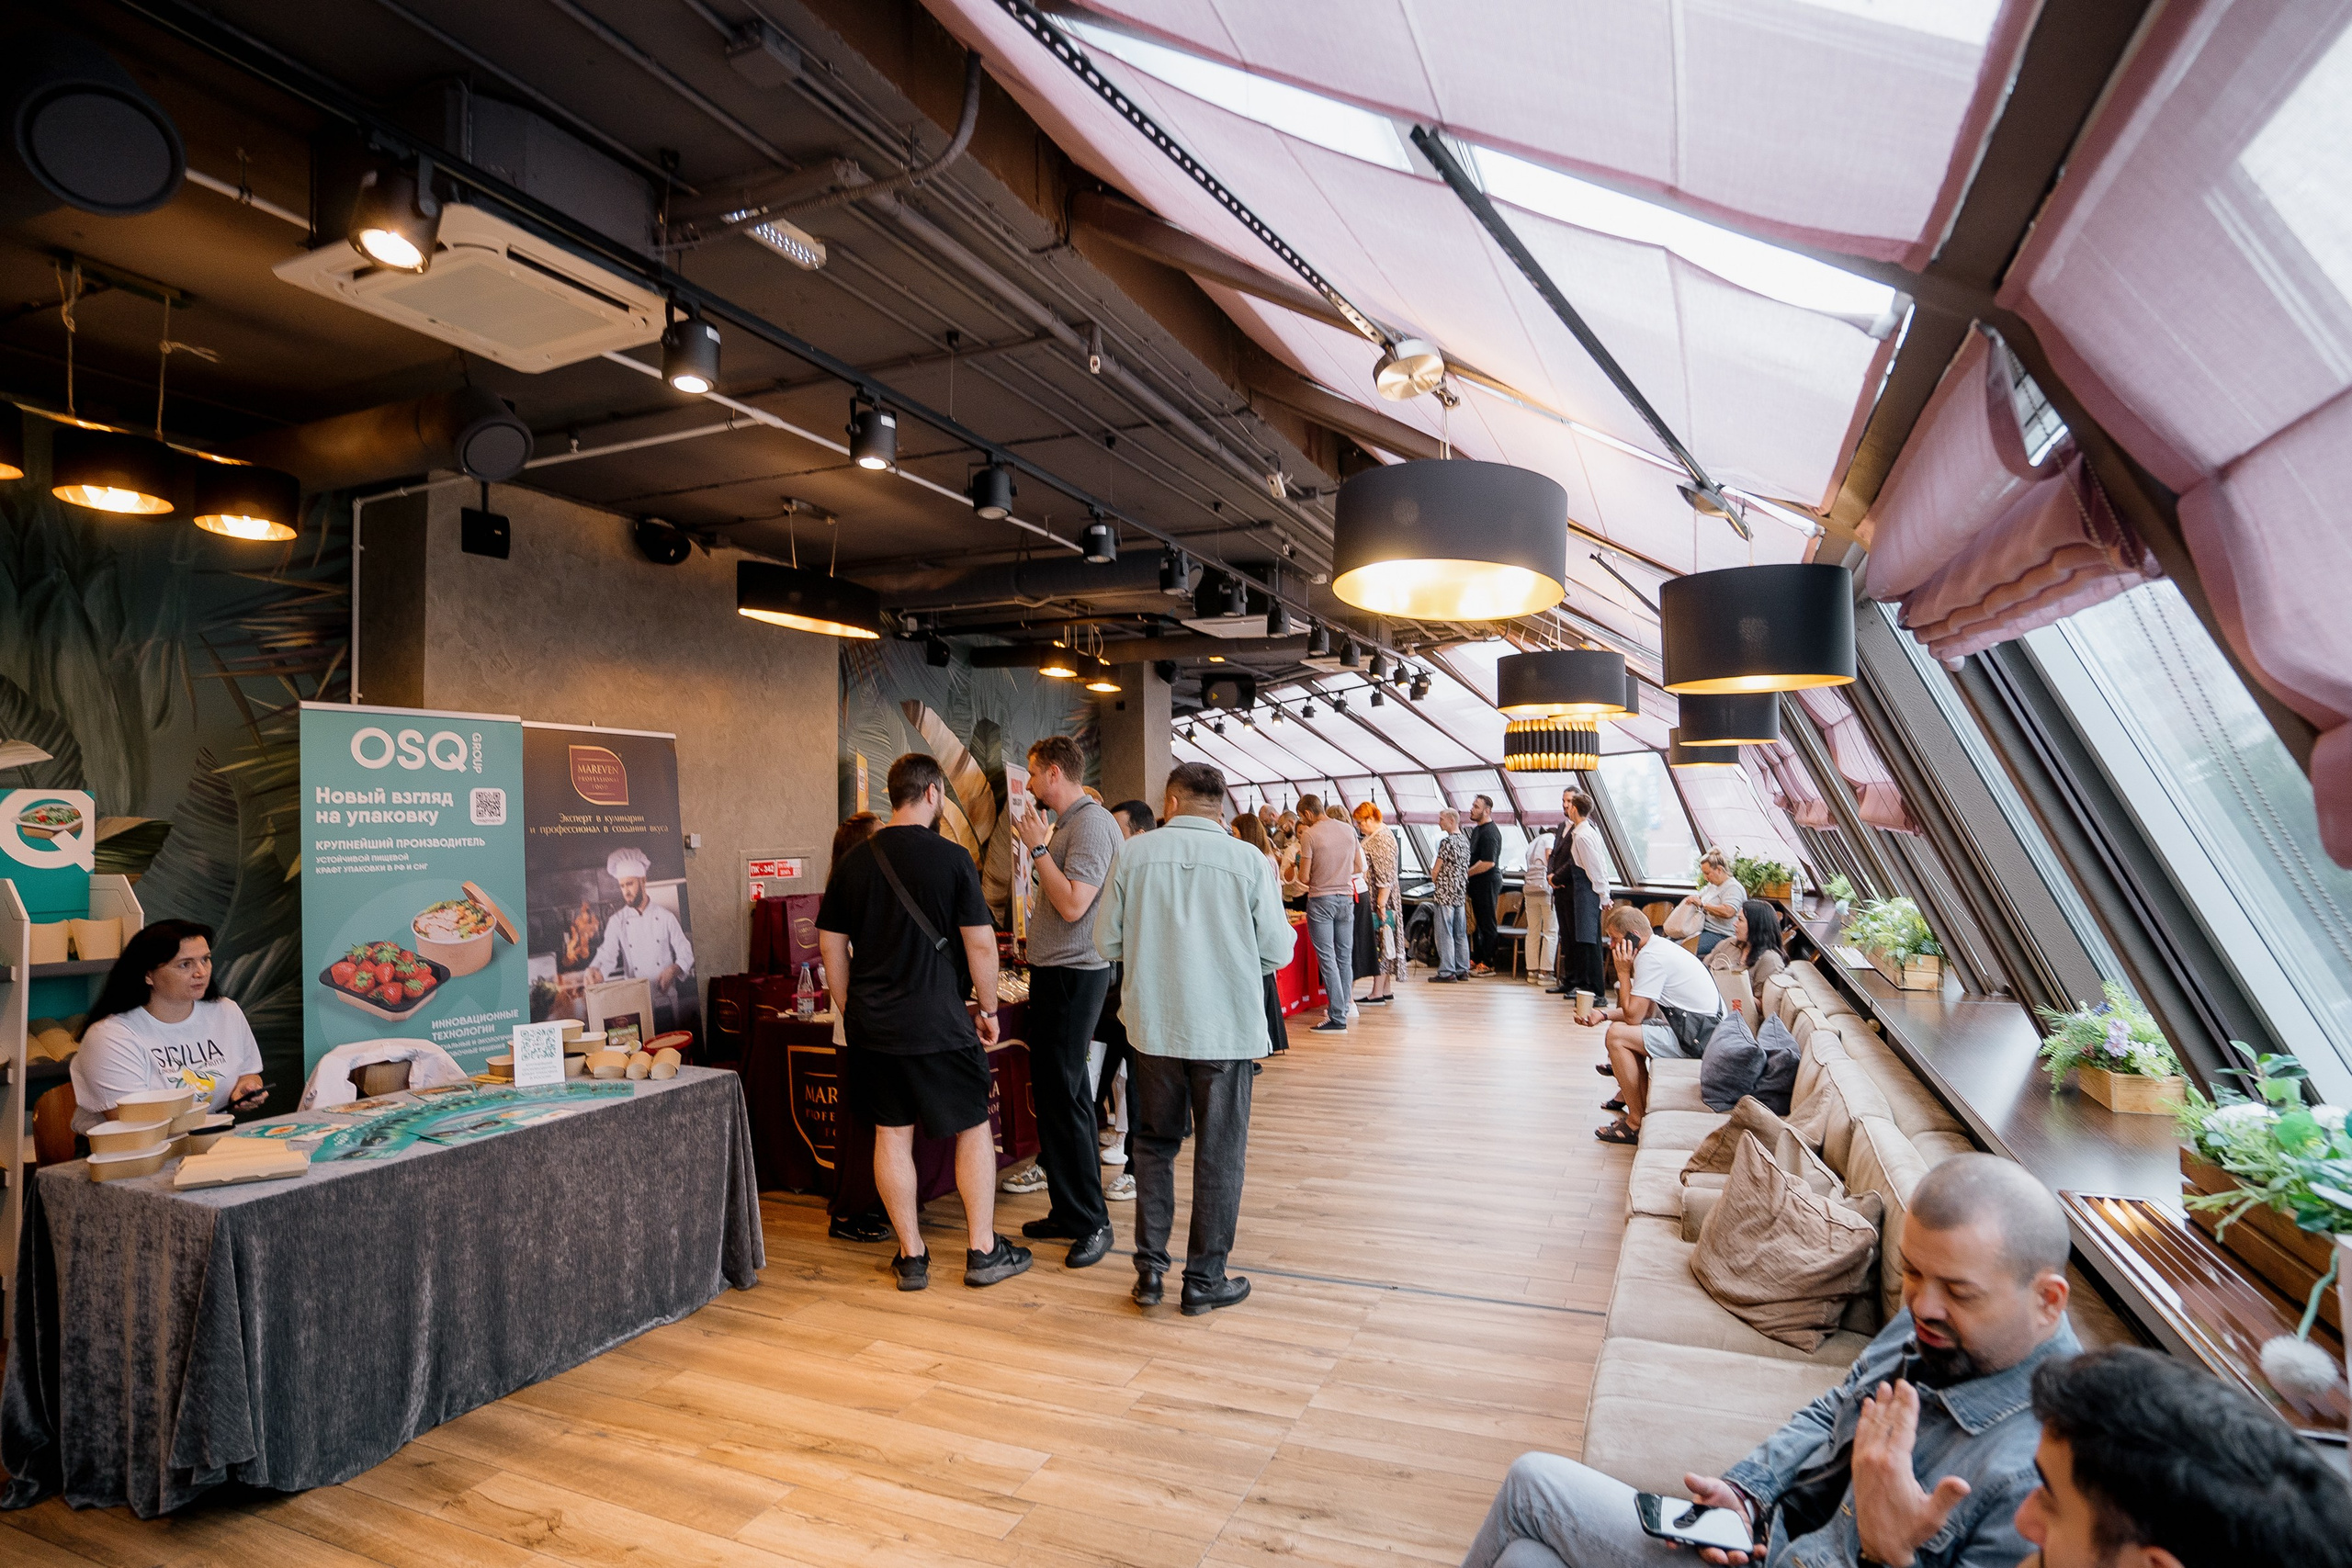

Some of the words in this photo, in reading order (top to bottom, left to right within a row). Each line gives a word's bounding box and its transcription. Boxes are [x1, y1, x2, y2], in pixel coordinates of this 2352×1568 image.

[350, 727, 469, 773] OSQ
[471, 732, 482, 774] GROUP
[577, 764, 619, 774] MAREVEN
[315, 786, 386, 805] Новый
[392, 792, 454, 807] взгляд
[315, 810, 341, 824] на
[346, 810, 439, 828] упаковку
[559, 813, 593, 825] Эксперт
[596, 815, 602, 823] в
[605, 815, 645, 825] кулинарии
[540, 824, 601, 837] профессионал
[612, 825, 647, 833] создании
[650, 825, 669, 835] вкуса
[315, 837, 394, 851] КРУПНЕЙШИЙ
[396, 837, 486, 849] ПРОИЗВОДИТЕЛЬ
[315, 853, 369, 864] УСТОЙЧИВОЙ
[371, 852, 409, 863] ПИЩЕВОЙ
[315, 866, 342, 874] КРАФТ
[344, 864, 386, 874] УПАКОВКИ
[387, 863, 393, 872] В
[394, 863, 405, 872] РФ
[413, 863, 428, 871] СНГ
[431, 1009, 519, 1030] ИННОВАЦИОННЫЕ
[431, 1024, 495, 1041] ТЕХНОЛОГИИ
[151, 1039, 225, 1067] SICILIA
